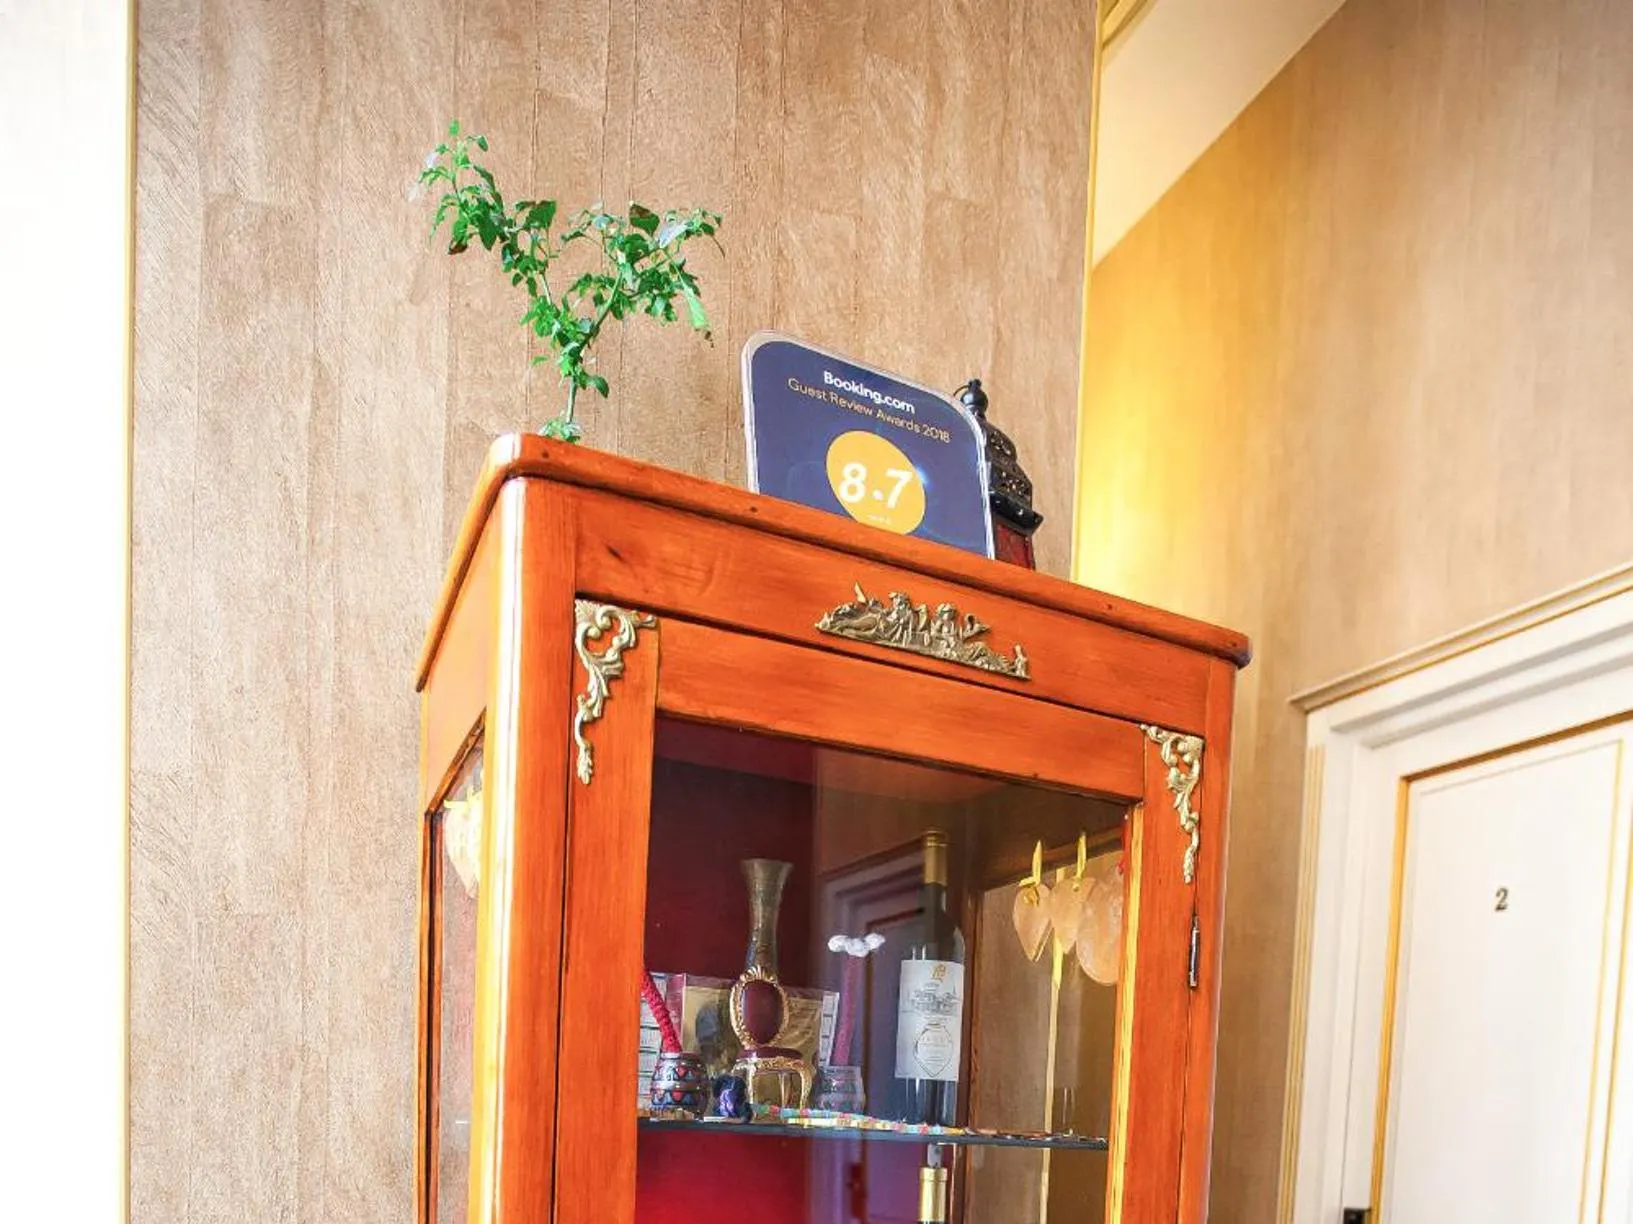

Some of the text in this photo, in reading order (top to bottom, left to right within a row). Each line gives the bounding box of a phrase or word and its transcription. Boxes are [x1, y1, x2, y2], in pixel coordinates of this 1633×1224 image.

[788, 378, 951, 443] Guest Review Awards 2018
[823, 370, 915, 414] Booking.com
[840, 462, 913, 509] 8.7
[1495, 887, 1508, 912] 2
